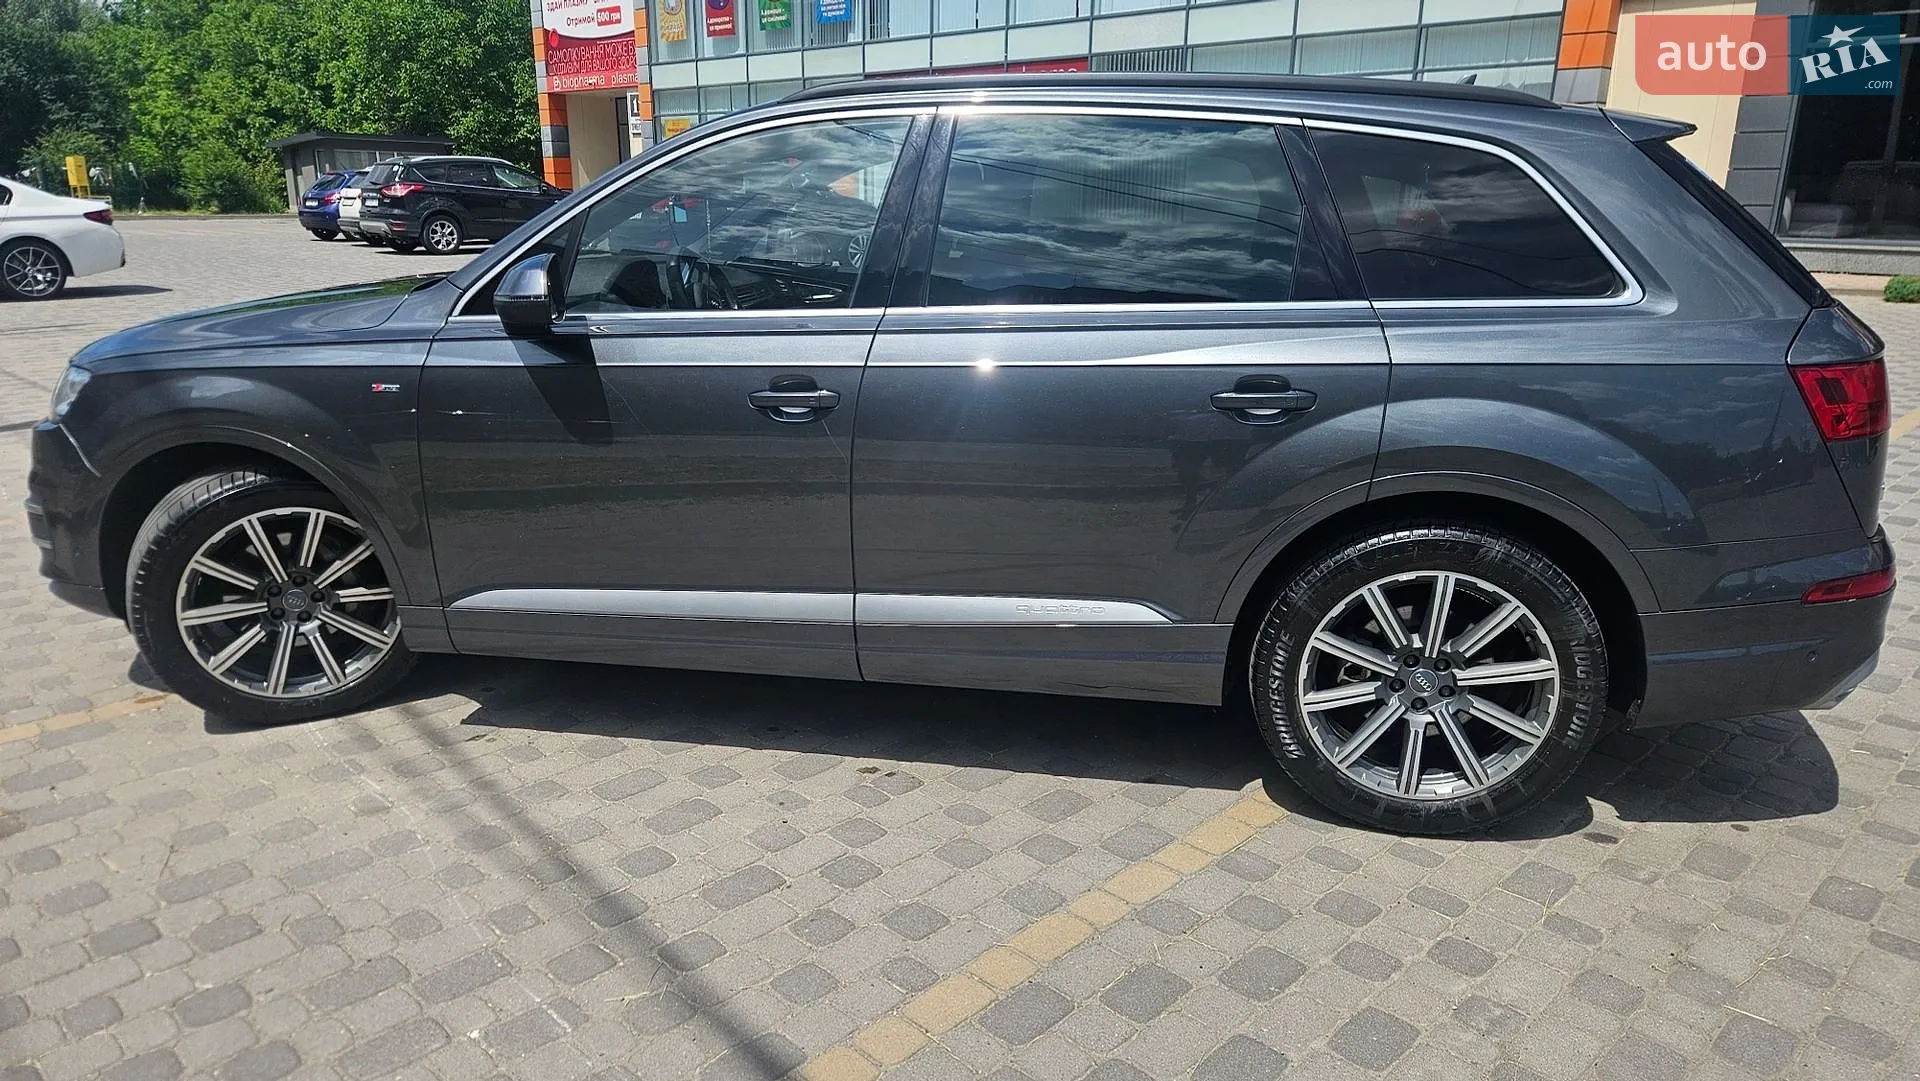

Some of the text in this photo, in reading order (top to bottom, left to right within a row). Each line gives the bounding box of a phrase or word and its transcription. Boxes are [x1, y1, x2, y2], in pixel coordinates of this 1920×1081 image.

[567, 11, 620, 27] Отримай 500 грн
[605, 42, 628, 57] МОЖЕ
[563, 72, 639, 89] biopharma plasma
[1016, 604, 1105, 616] quattro
[1268, 629, 1306, 759] BRIDGESTONE
